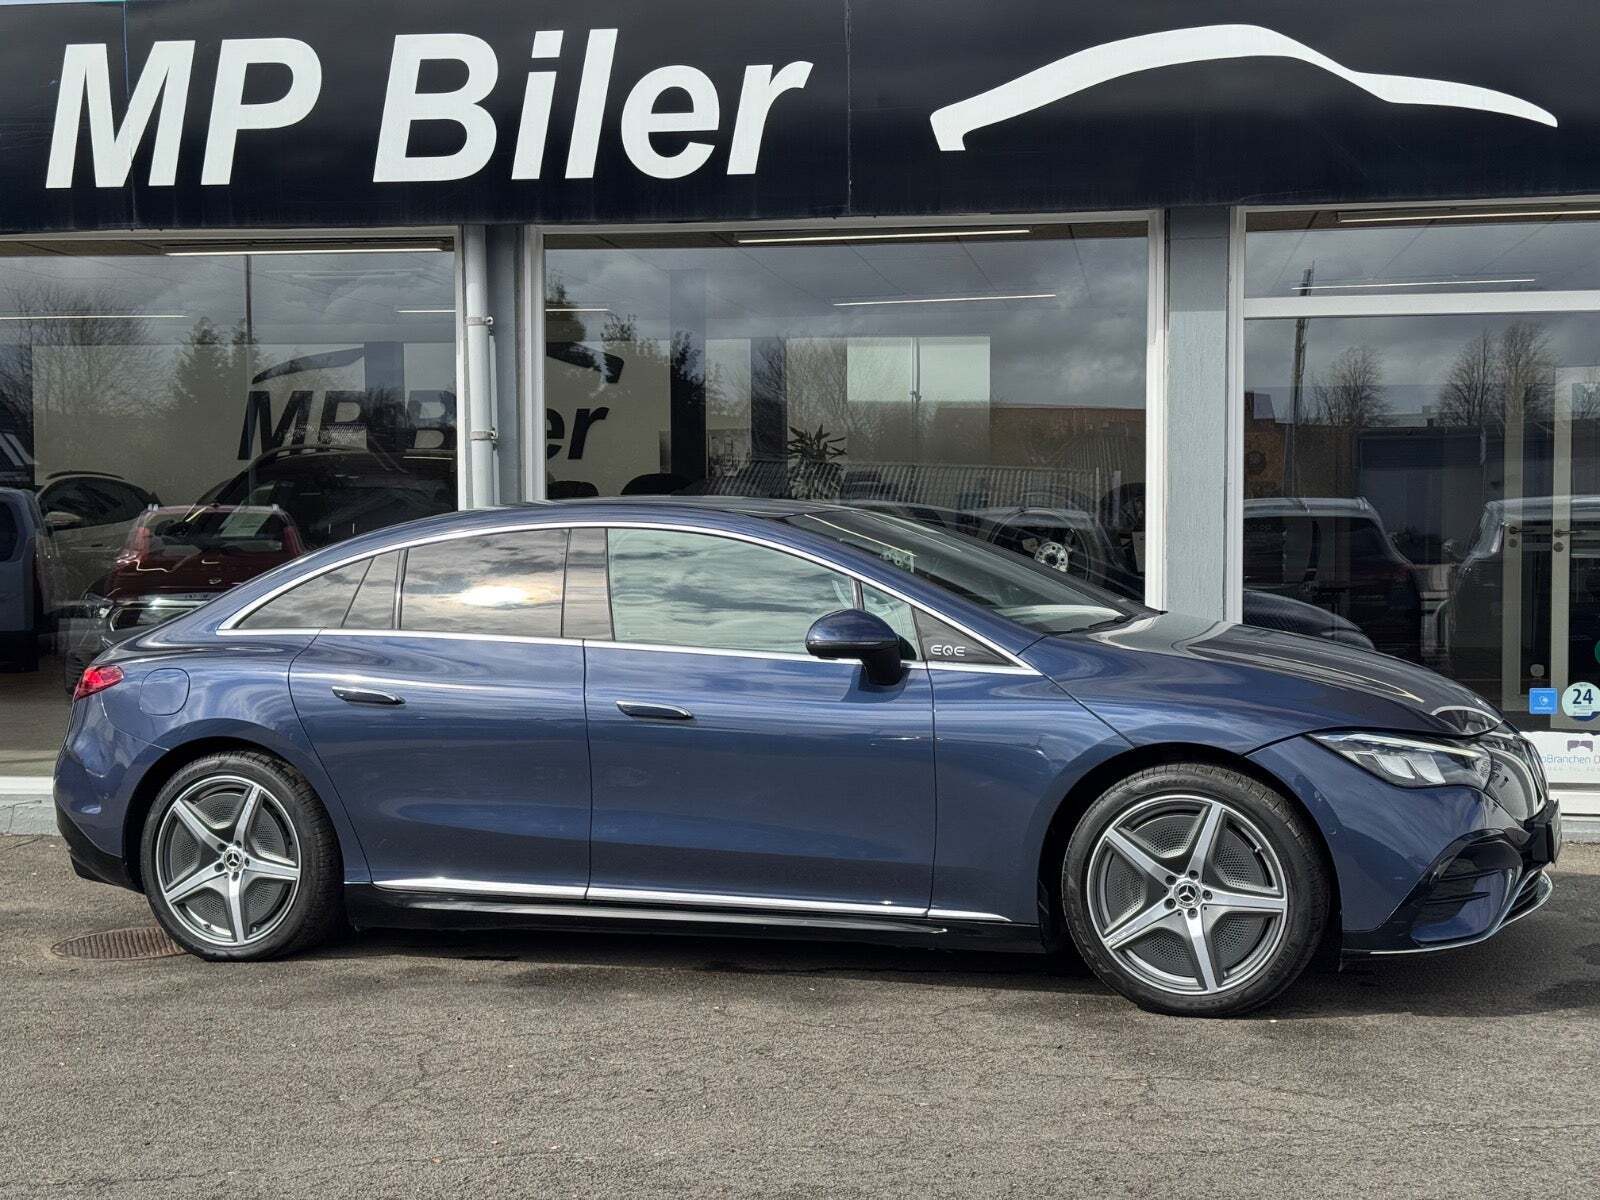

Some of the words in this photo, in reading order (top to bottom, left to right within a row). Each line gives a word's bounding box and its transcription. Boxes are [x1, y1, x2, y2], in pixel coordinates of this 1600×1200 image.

[45, 37, 323, 189] MP
[372, 28, 814, 182] Biler
[237, 390, 368, 461] MP
[930, 644, 966, 657] EQE
[1572, 688, 1594, 705] 24
